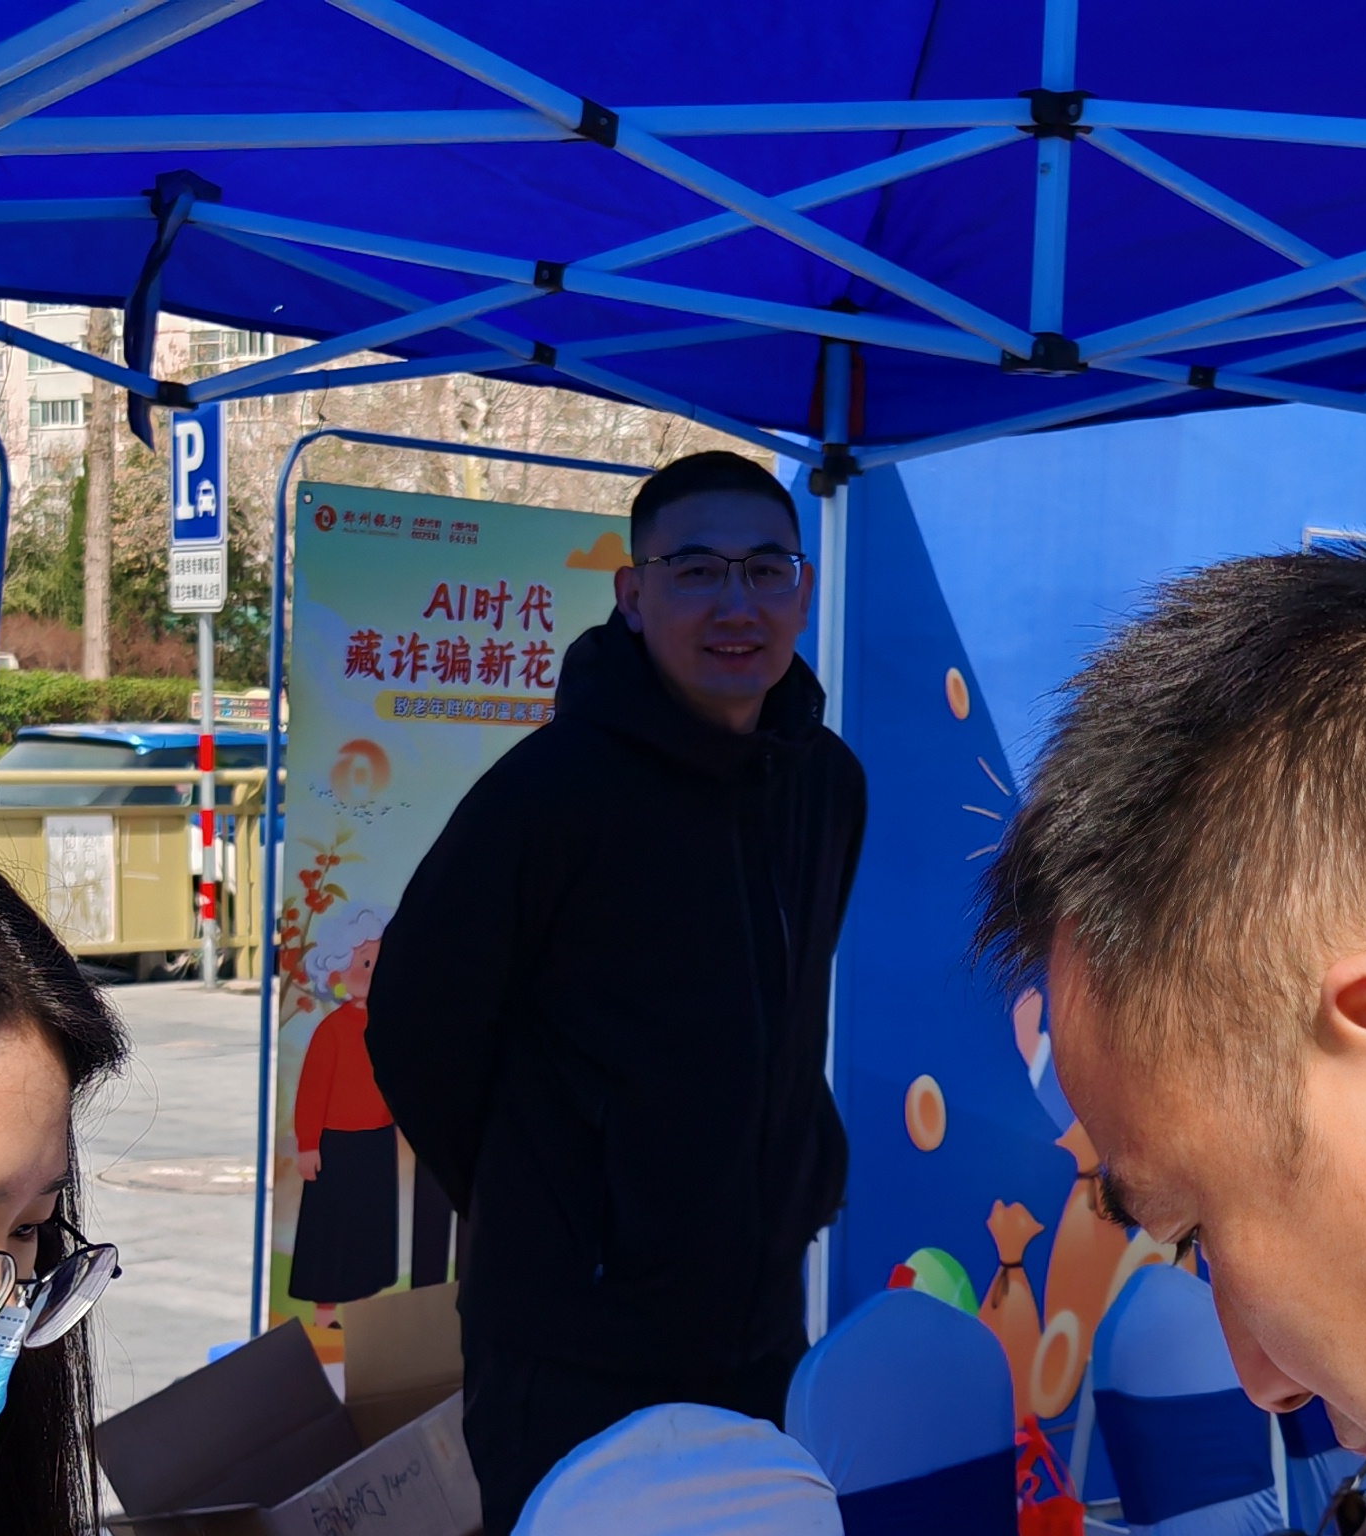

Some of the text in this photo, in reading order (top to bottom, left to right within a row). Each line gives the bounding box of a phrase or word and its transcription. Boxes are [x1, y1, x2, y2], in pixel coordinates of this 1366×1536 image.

[175, 420, 205, 520] P
[424, 581, 554, 632] AI时代
[344, 630, 556, 690] 藏诈骗新花
